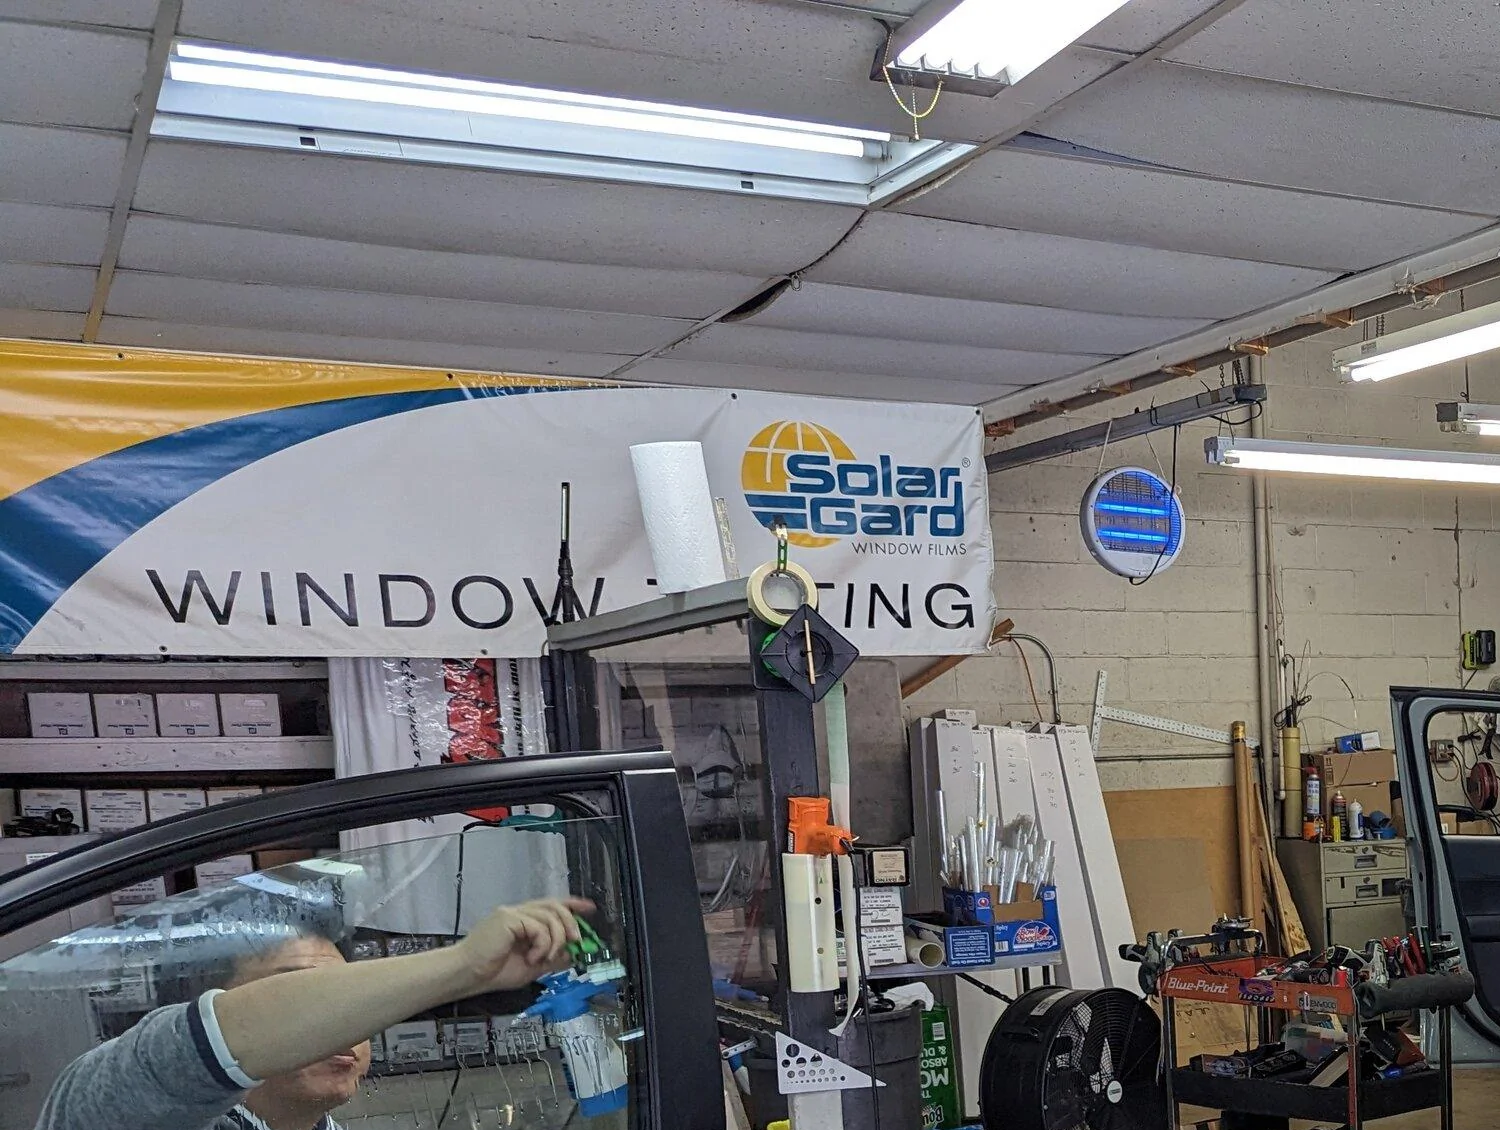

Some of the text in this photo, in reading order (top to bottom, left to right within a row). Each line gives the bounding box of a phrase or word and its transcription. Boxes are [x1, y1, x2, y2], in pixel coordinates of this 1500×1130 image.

[786, 454, 960, 499] Solar
[810, 481, 965, 537] Gard
[852, 542, 967, 556] WINDOW FILMS
[145, 569, 605, 629] WINDOW
[1168, 977, 1230, 994] Blue-Point
[920, 1056, 948, 1068] ABSO
[919, 1067, 949, 1089] MO
